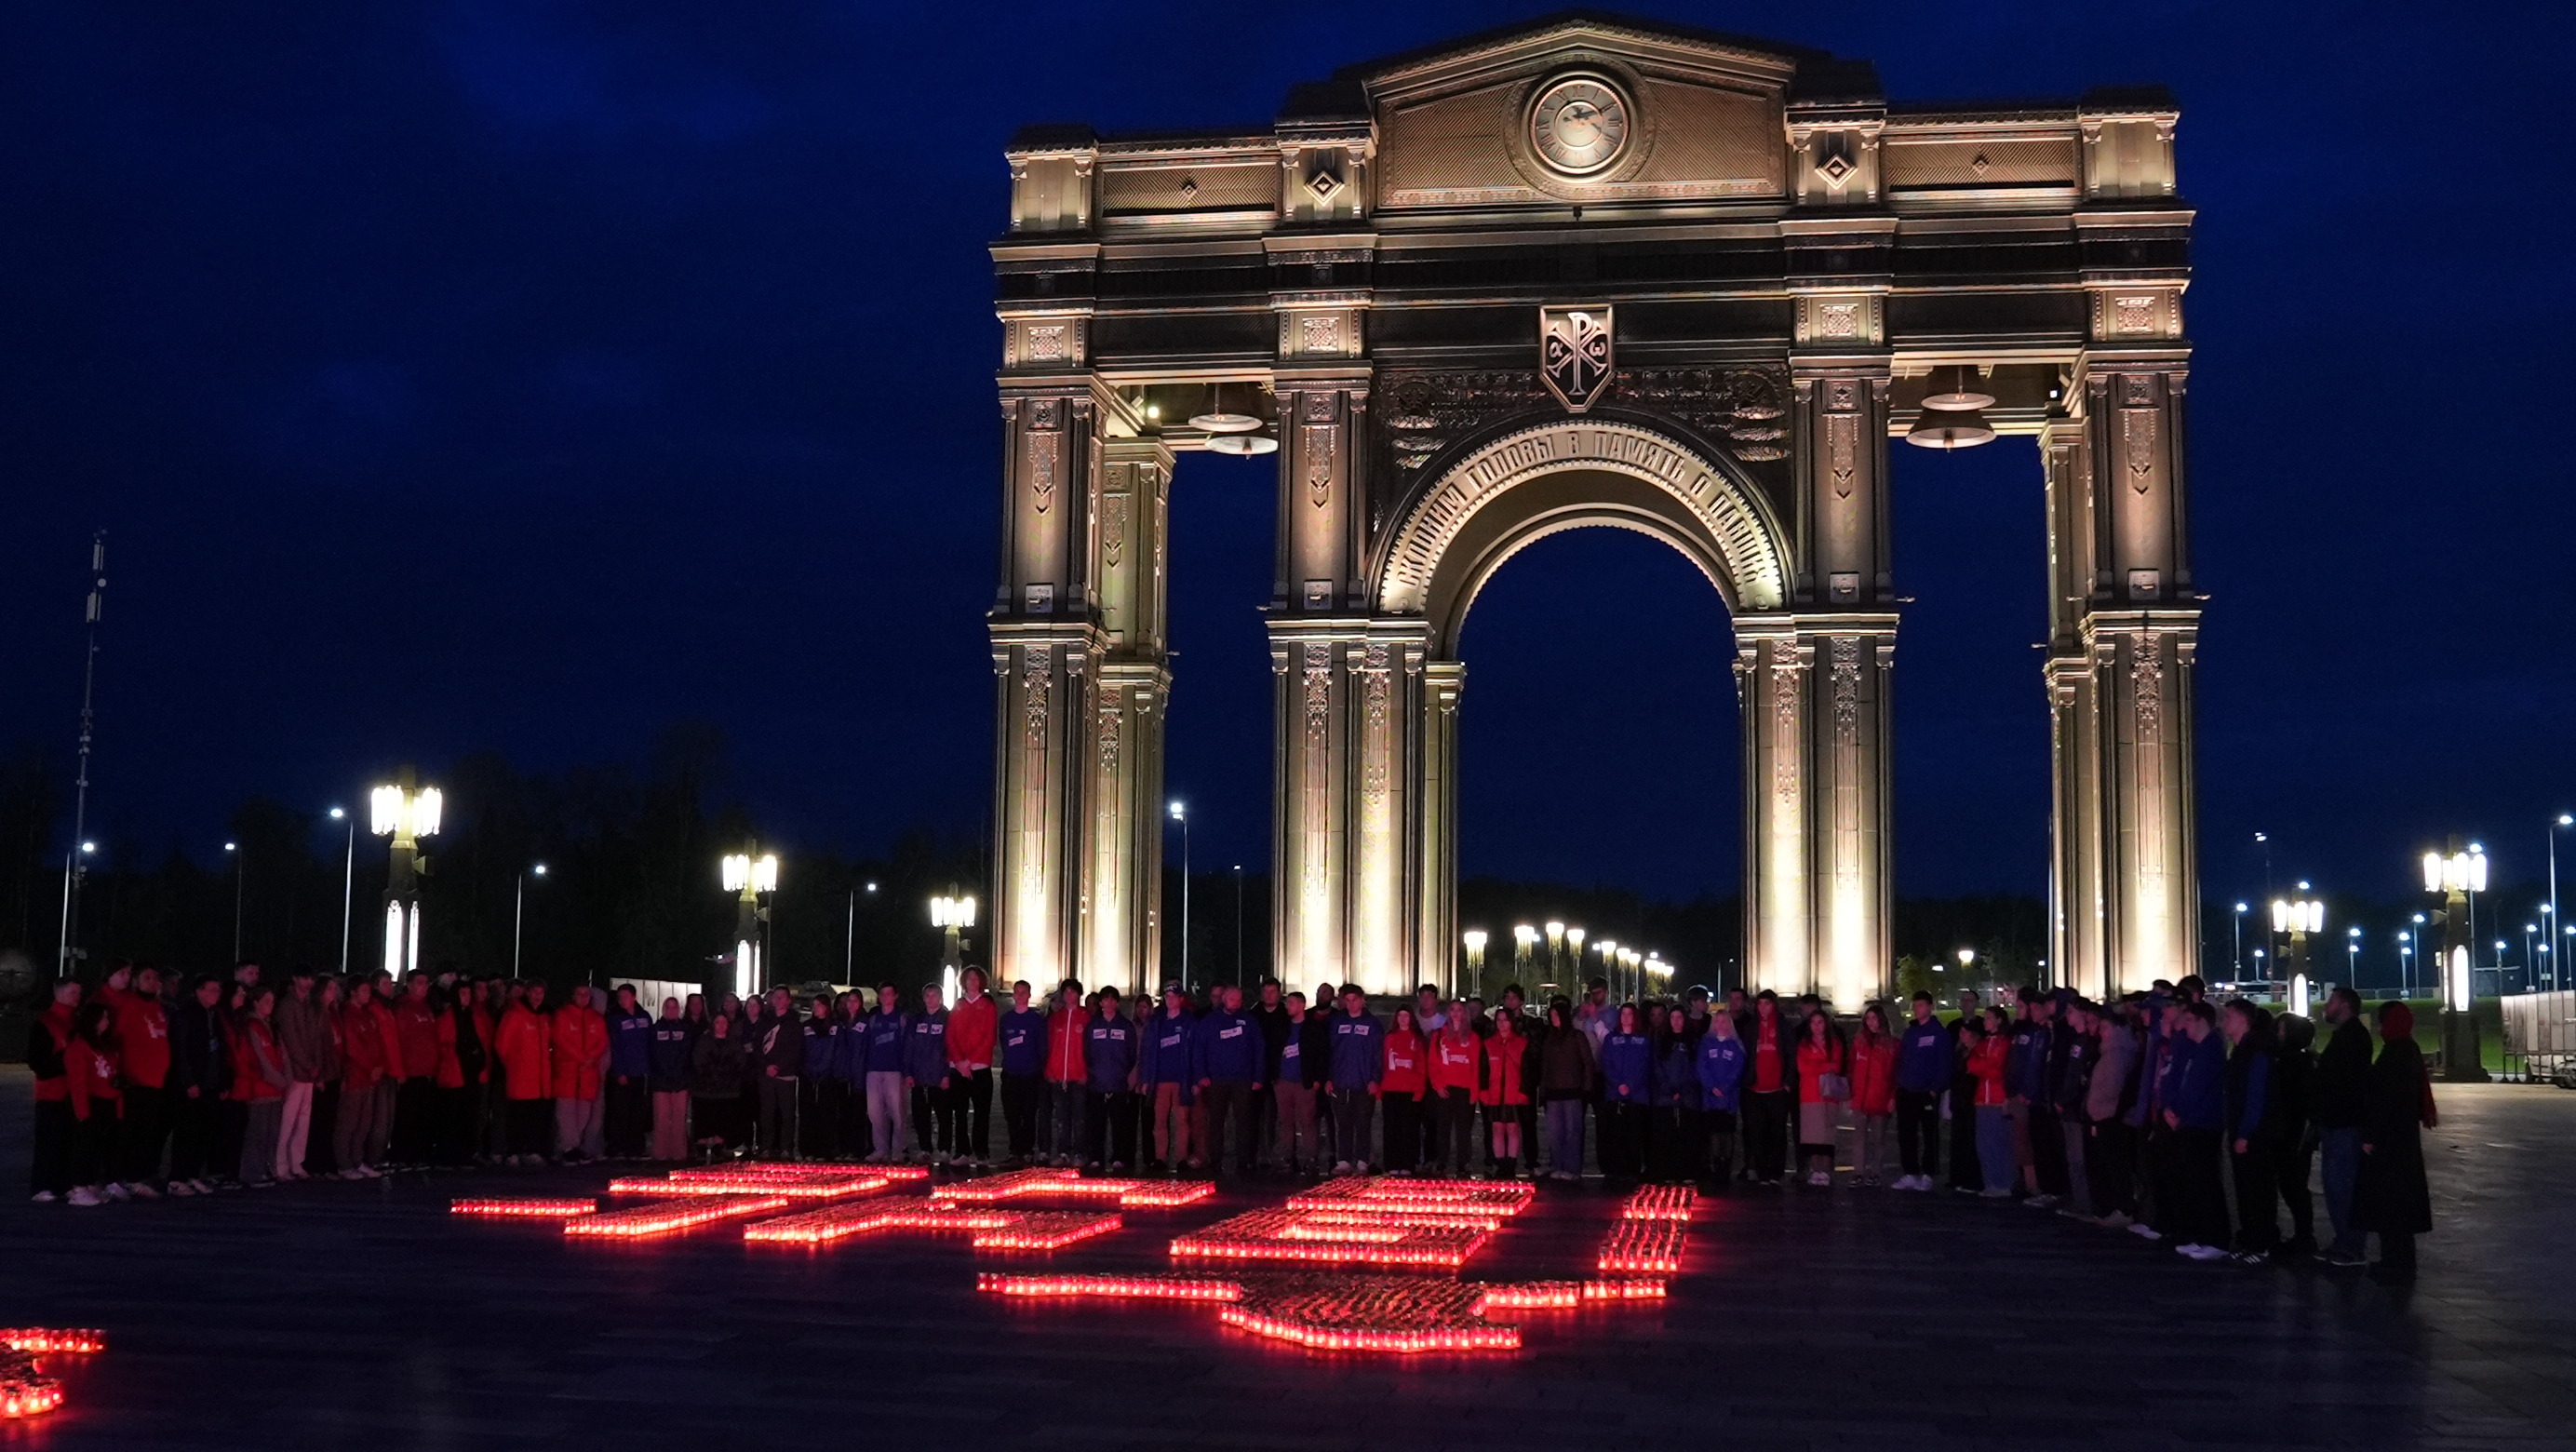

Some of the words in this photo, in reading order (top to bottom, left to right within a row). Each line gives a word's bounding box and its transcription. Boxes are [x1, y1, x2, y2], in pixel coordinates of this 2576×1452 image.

[1397, 481, 1469, 589] СКЛОНИМ
[1465, 434, 1555, 492] ГОЛОВЫ
[1566, 431, 1581, 457] В
[1594, 431, 1687, 483] ПАМЯТЬ
[1690, 471, 1711, 499] О
[1708, 490, 1767, 585] ПАВШИХ
